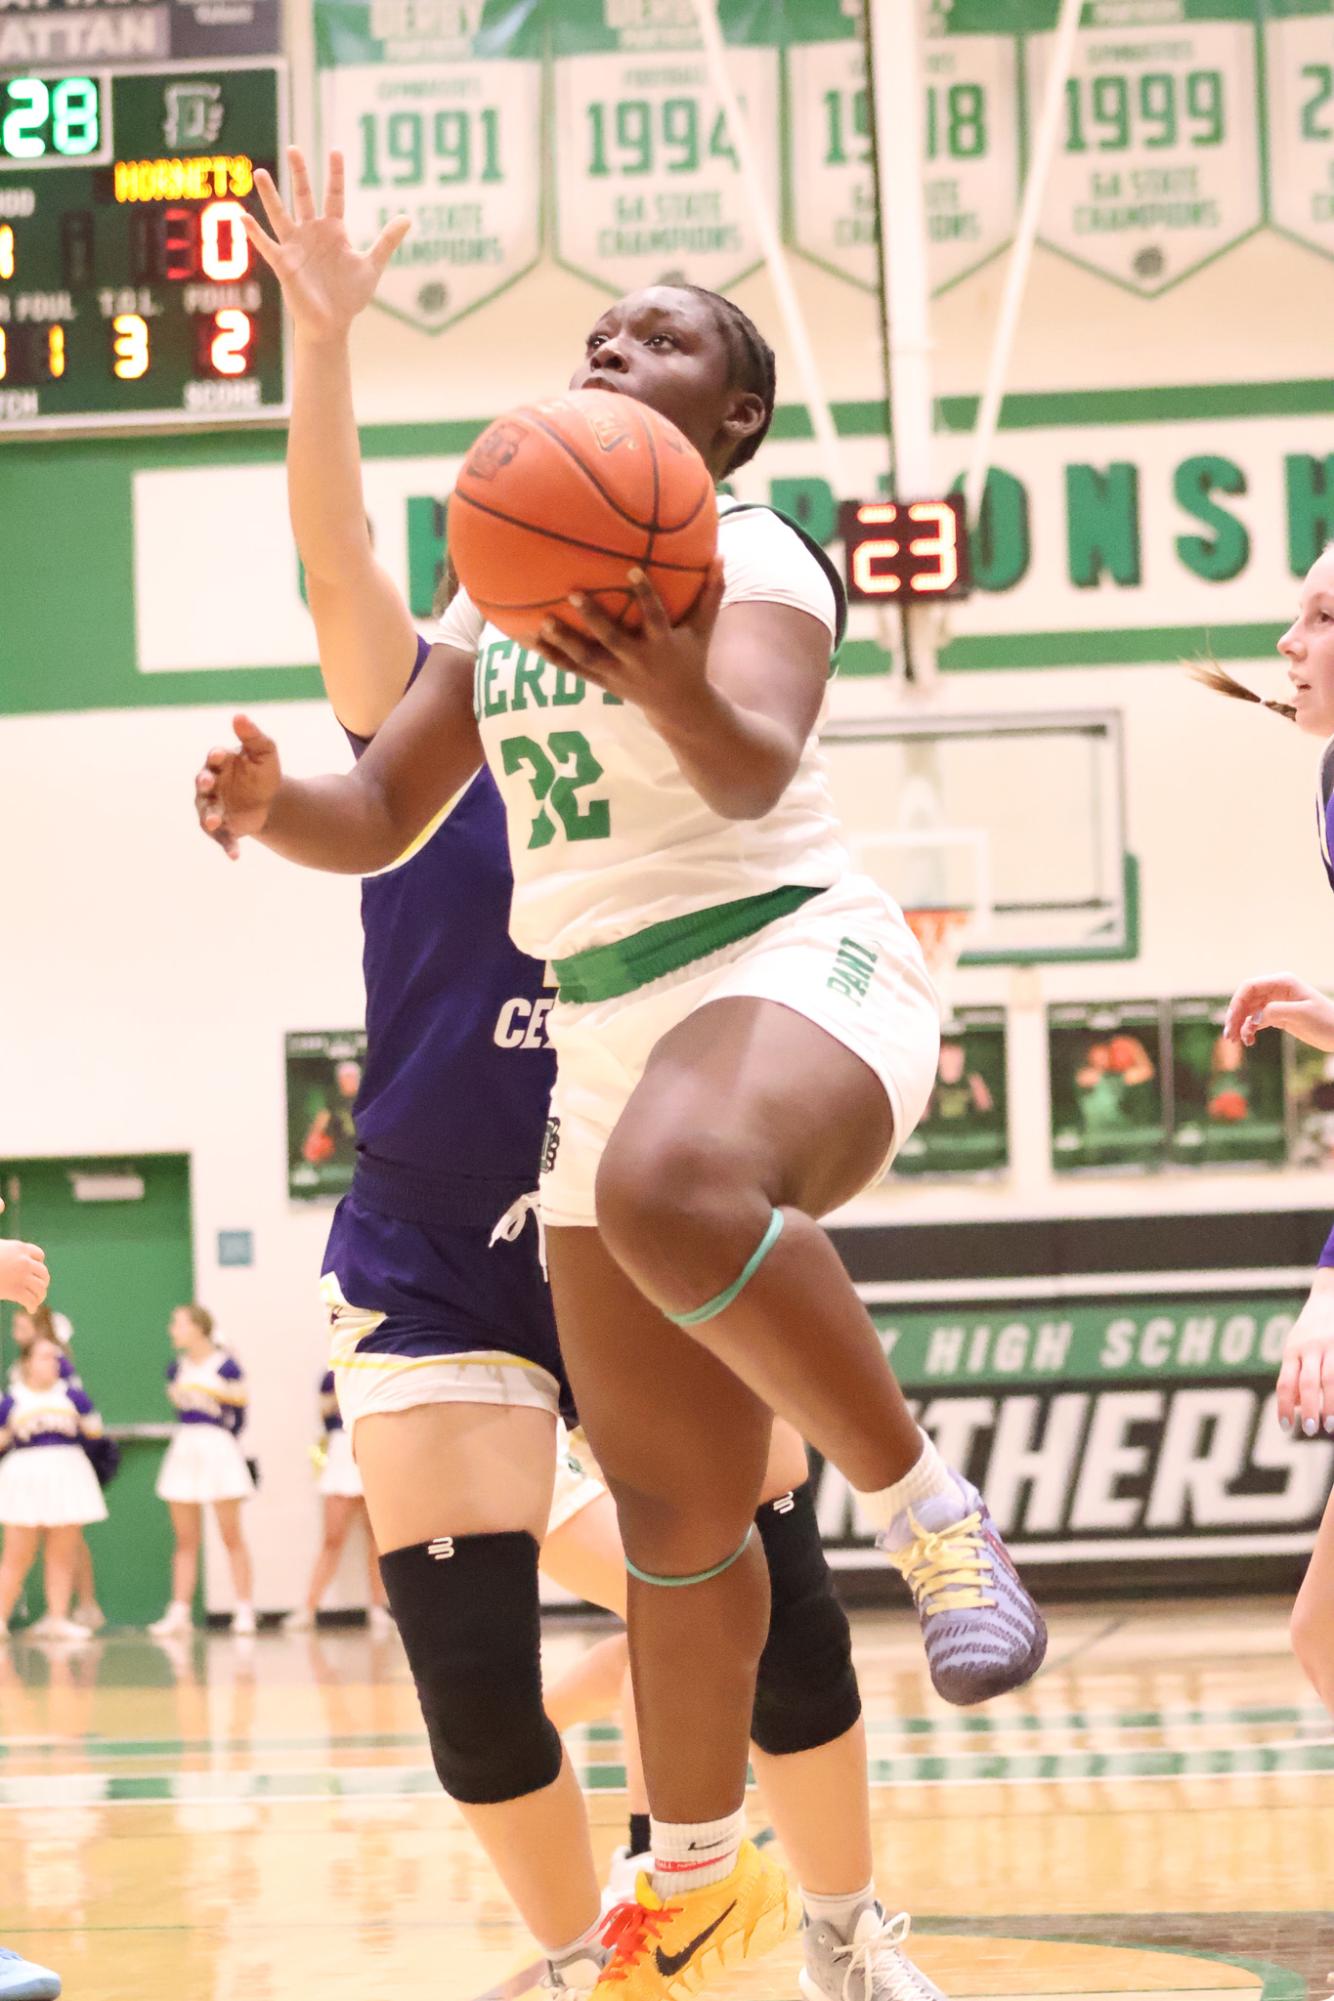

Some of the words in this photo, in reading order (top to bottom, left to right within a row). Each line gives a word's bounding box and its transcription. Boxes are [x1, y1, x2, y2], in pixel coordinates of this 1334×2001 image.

[3, 78, 98, 157] 28
[359, 108, 504, 188] 1991
[587, 98, 748, 176] 1994
[1065, 70, 1222, 152] 1999
[114, 155, 253, 202] HORNETS
[113, 313, 149, 379] 3
[211, 308, 250, 374] 2
[852, 500, 958, 594] 23
[500, 731, 611, 850] 32
[493, 997, 557, 1048] CE
[924, 1320, 1075, 1377] HIGH
[1099, 1313, 1297, 1372] SCHOO
